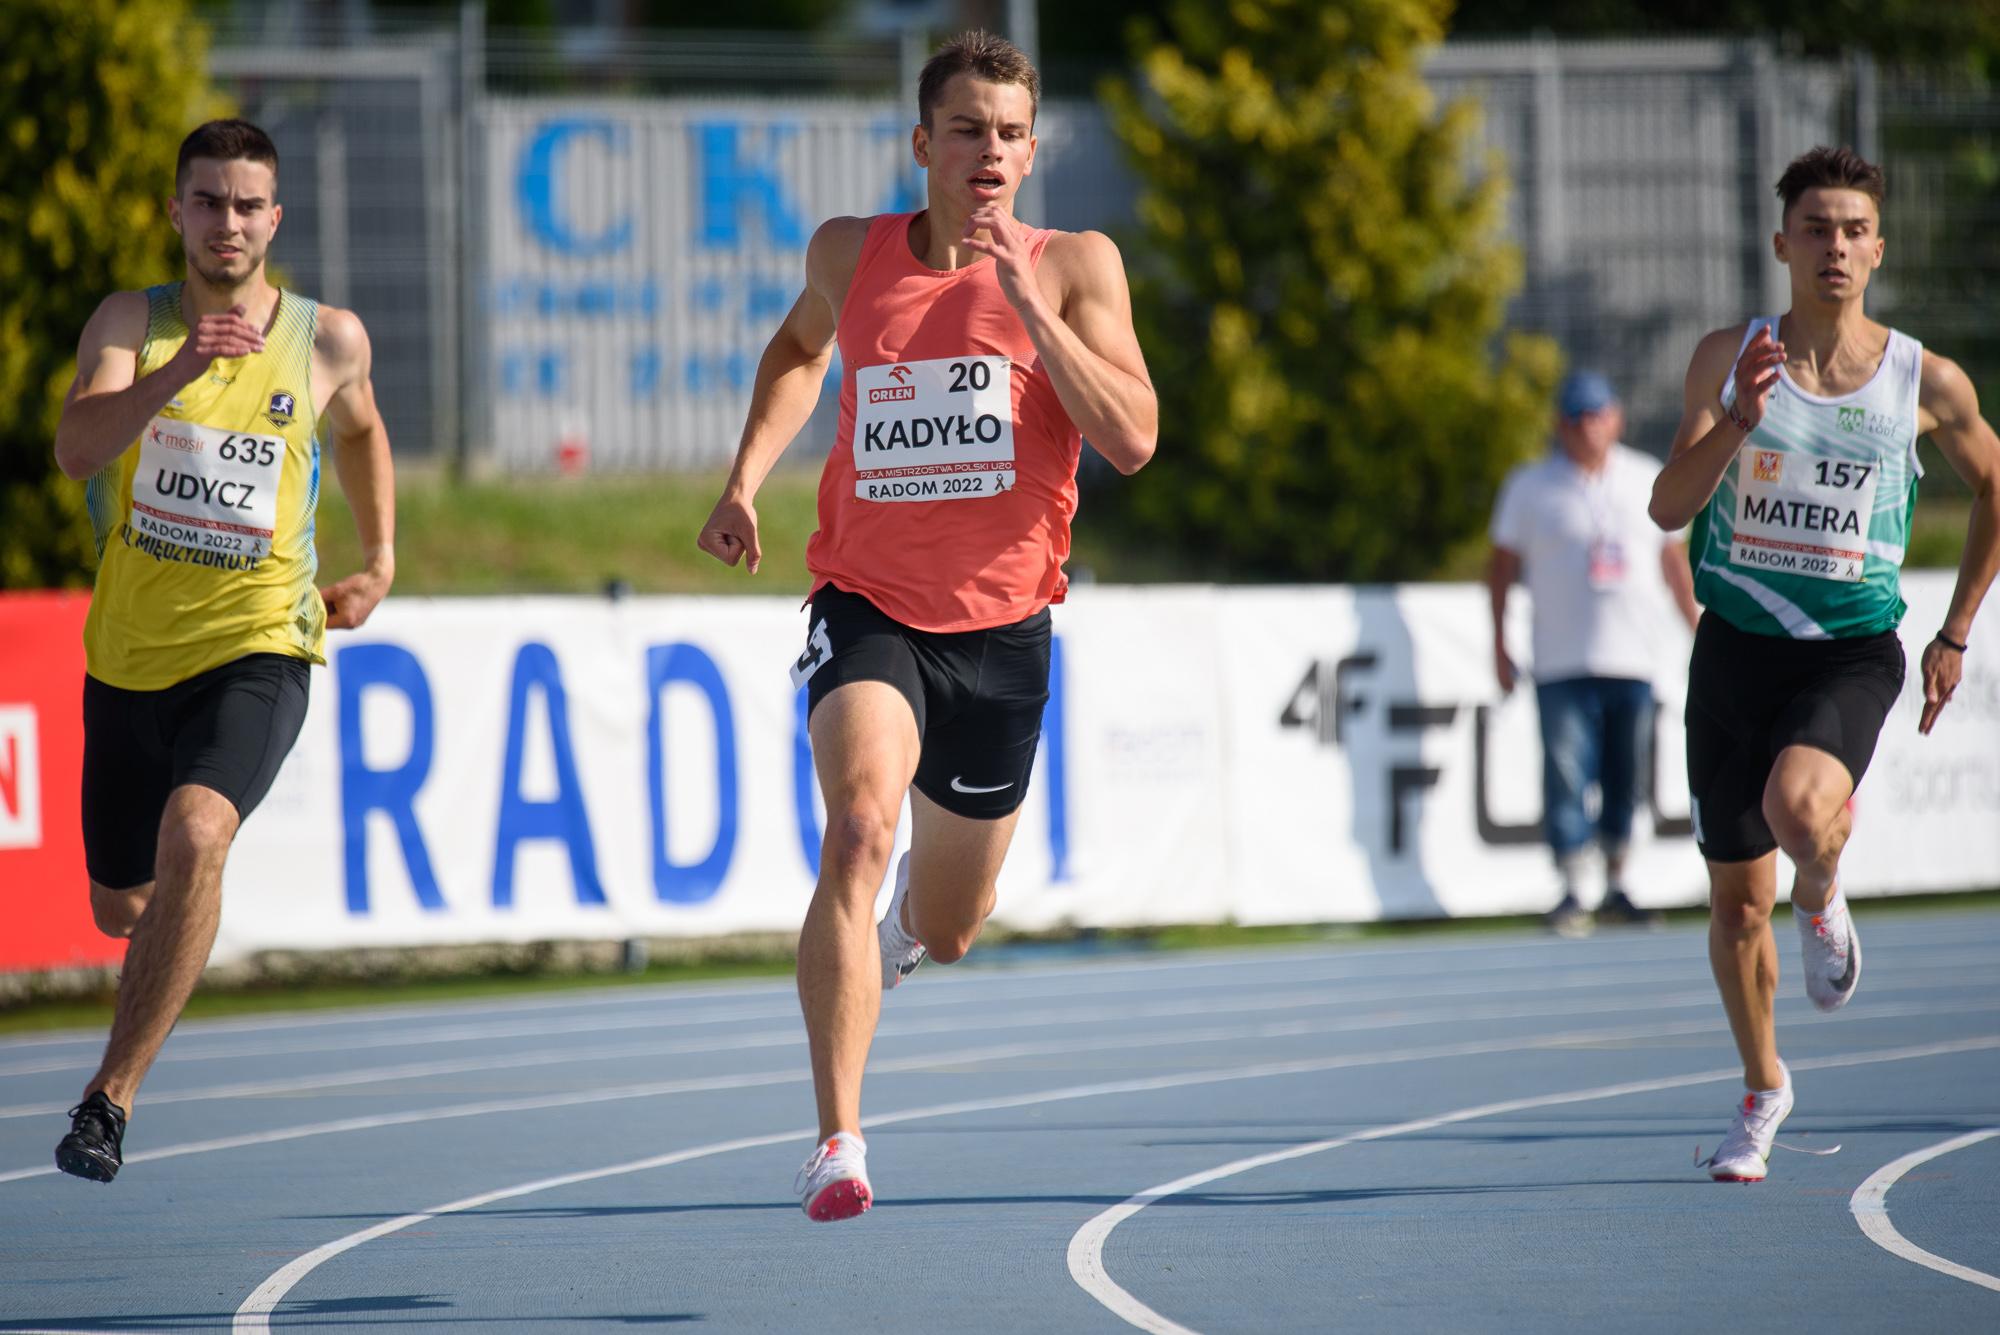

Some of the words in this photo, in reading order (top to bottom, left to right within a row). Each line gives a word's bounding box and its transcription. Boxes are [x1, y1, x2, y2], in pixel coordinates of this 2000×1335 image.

[515, 113, 928, 258] CK
[949, 361, 991, 393] 20
[870, 387, 913, 402] ORLEN
[864, 413, 1002, 452] KADYŁO
[1871, 414, 1893, 424] AZS
[165, 433, 206, 451] mosir
[219, 435, 276, 467] 635
[860, 469, 884, 480] PZLA
[885, 465, 954, 477] MISTRZOSTWA
[954, 462, 989, 472] POLSKI
[990, 462, 1013, 470] U20
[1815, 460, 1872, 491] 157
[156, 468, 256, 510] UDYCZ
[868, 480, 938, 499] RADOM
[943, 477, 983, 494] 2022
[1743, 495, 1860, 536] MATERA
[140, 516, 199, 545] RADOM
[203, 533, 243, 551] 2022
[1740, 548, 1796, 569] RADOM
[1801, 557, 1838, 574] 2022
[1279, 654, 1380, 745] 4F
